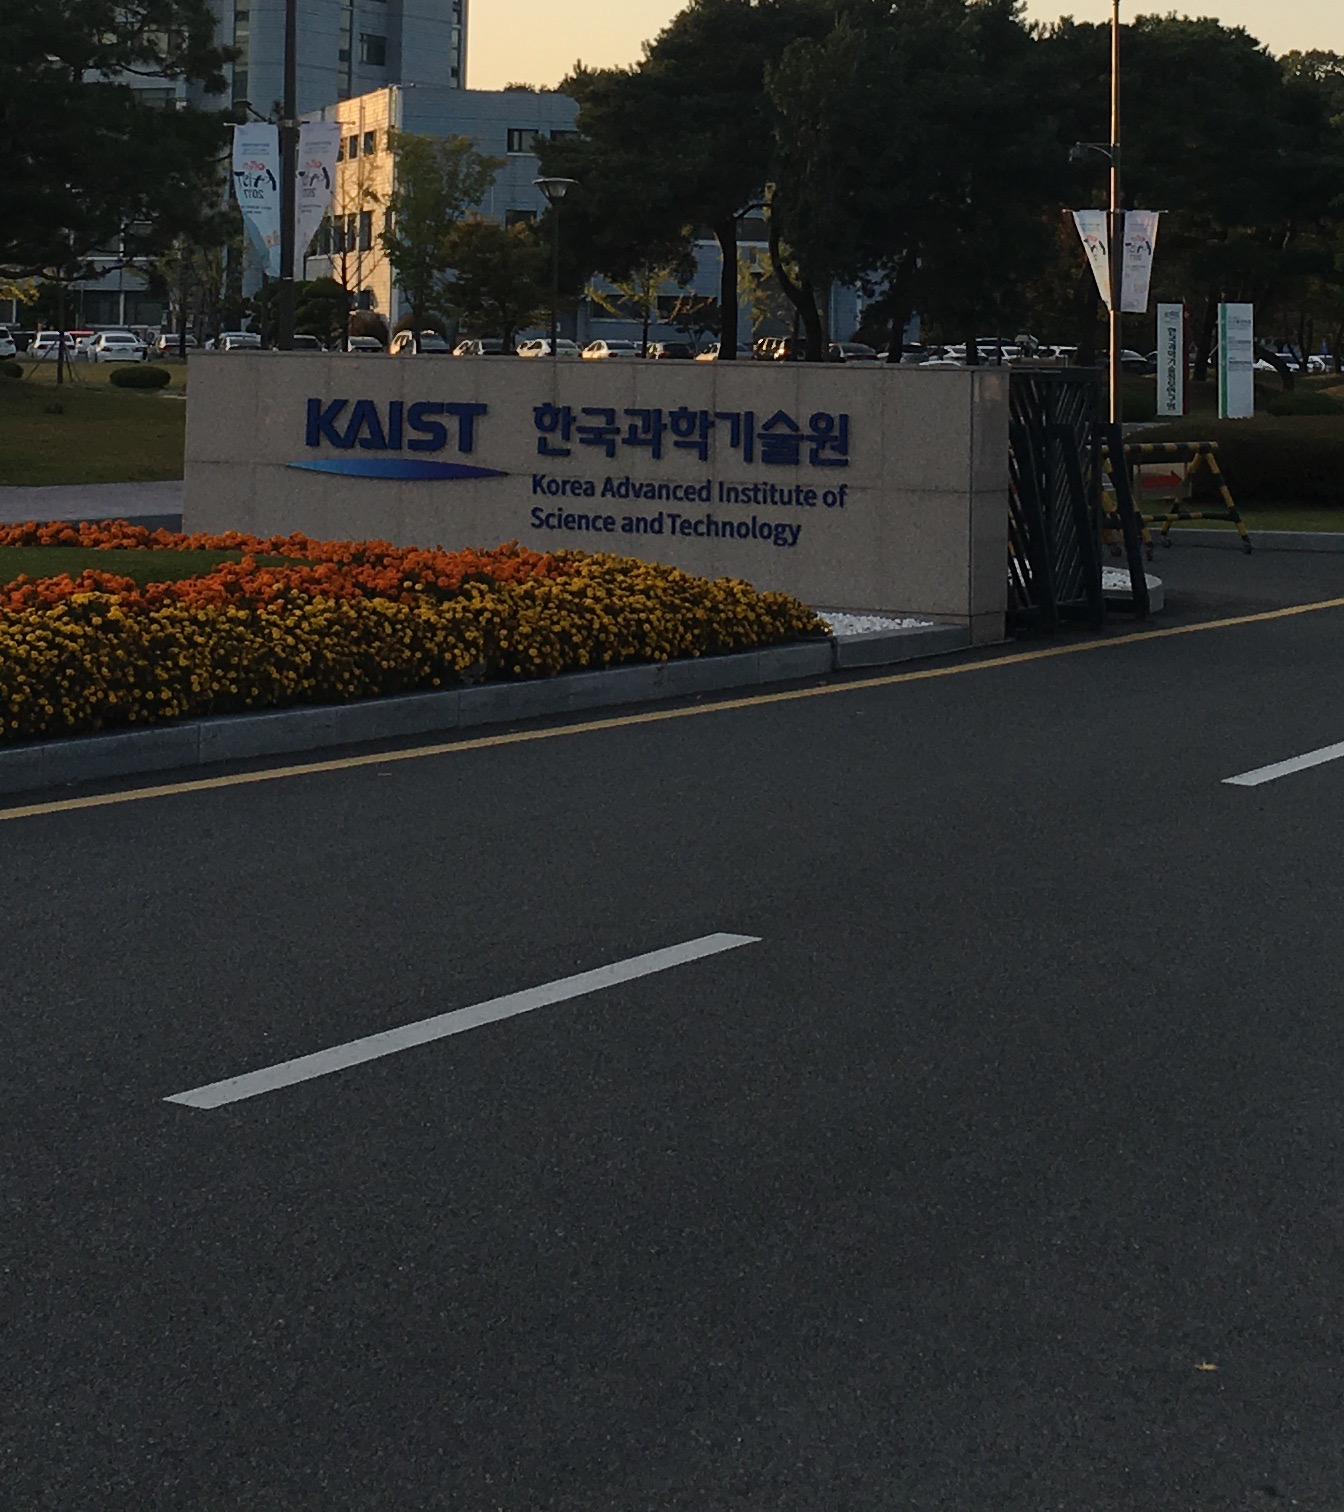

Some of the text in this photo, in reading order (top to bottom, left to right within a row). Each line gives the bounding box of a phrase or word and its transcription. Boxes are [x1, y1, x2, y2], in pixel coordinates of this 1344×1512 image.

[305, 398, 488, 453] KAIST
[532, 402, 850, 467] 한국과학기술원
[531, 473, 849, 509] Korea Advanced Institute of
[530, 507, 802, 547] Science and Technology
